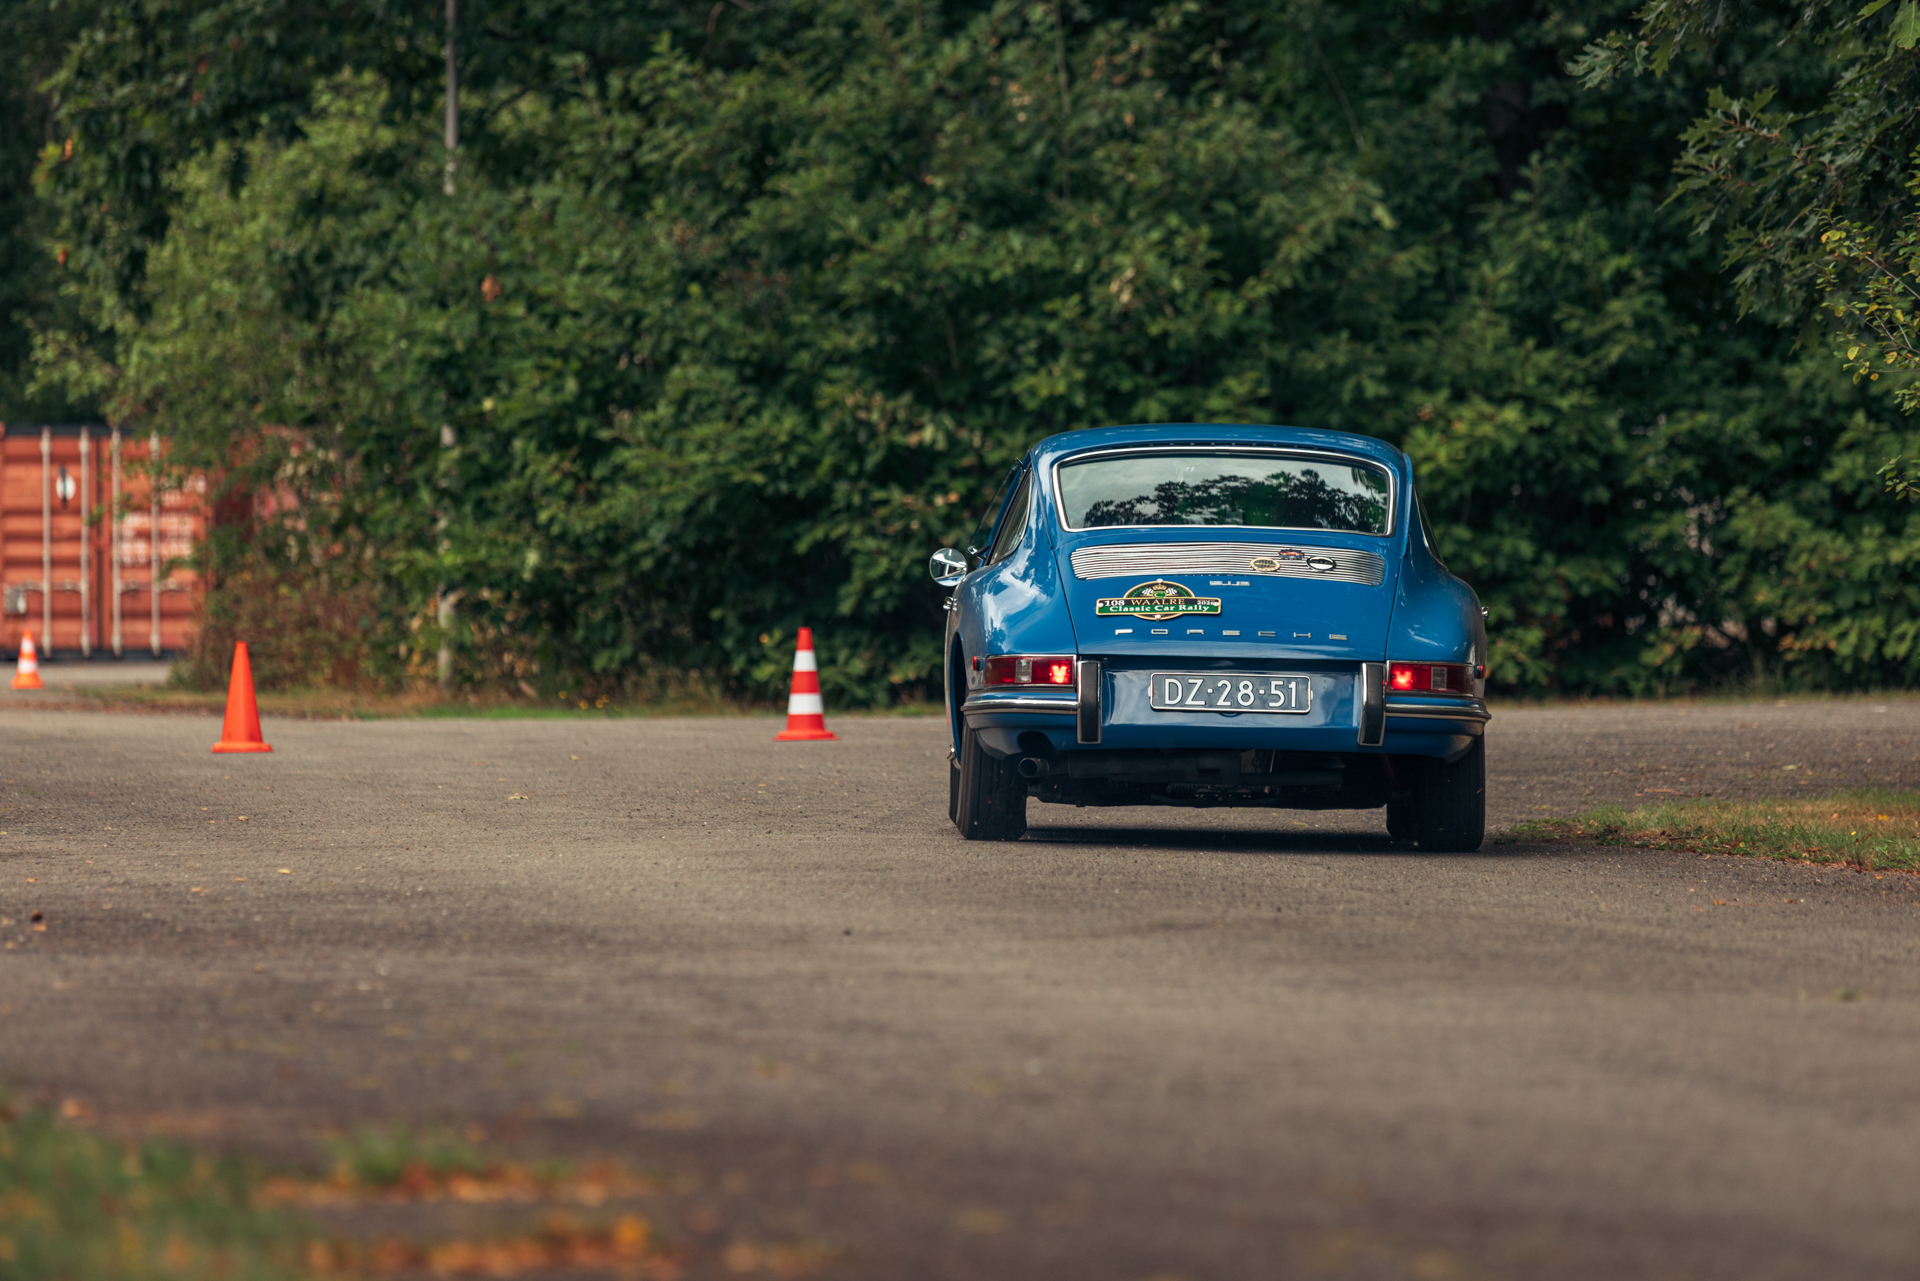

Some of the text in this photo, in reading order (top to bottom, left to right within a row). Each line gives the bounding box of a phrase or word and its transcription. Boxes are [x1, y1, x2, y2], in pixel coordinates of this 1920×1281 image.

[1154, 604, 1176, 612] Car
[1178, 604, 1210, 612] Rally
[1114, 628, 1348, 641] PORSCHE
